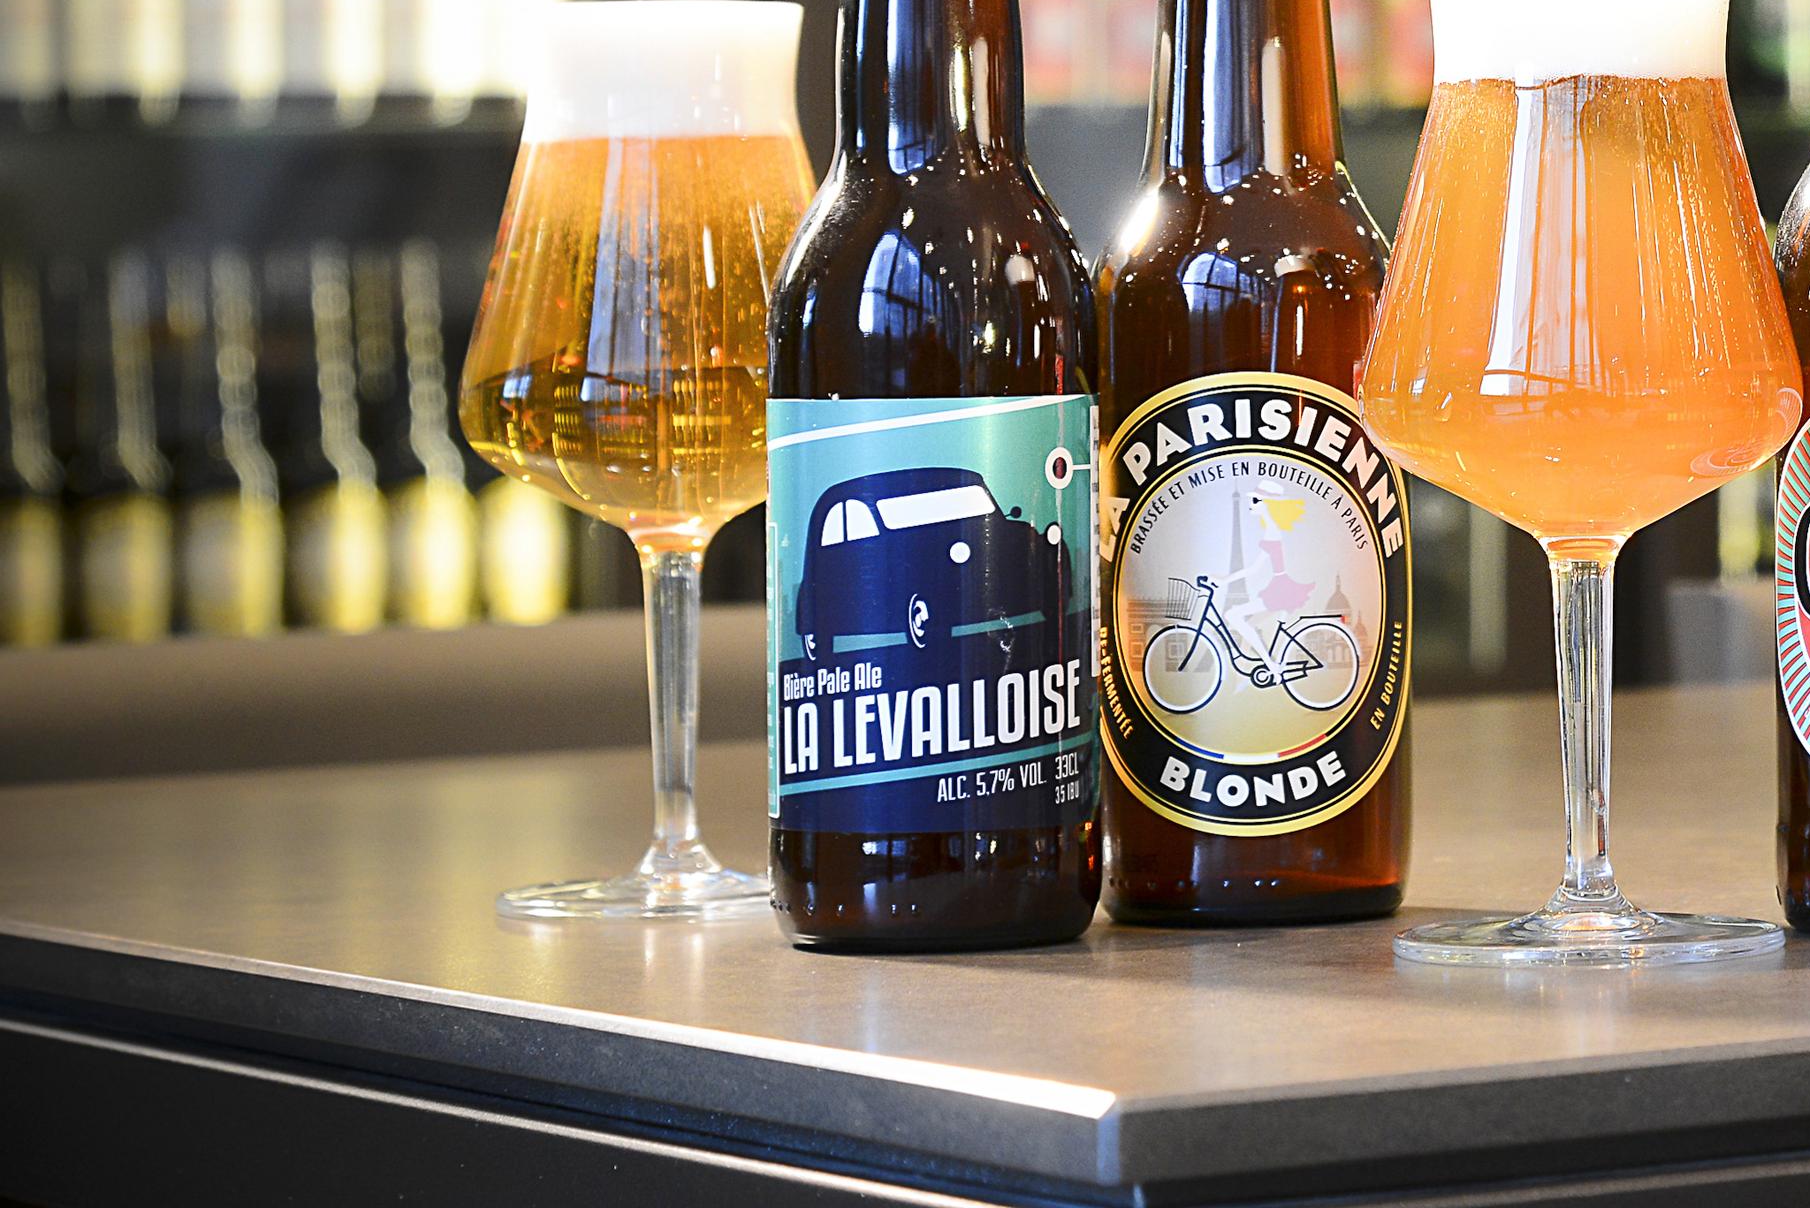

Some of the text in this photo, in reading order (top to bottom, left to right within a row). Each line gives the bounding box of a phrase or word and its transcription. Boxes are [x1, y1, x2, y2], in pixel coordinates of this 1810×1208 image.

[1121, 398, 1404, 558] PARISIENNE
[1130, 461, 1368, 554] BRASSÉE ET MISE EN BOUTEILLE À PARIS
[783, 662, 882, 701] Bière Pale Ale
[1370, 621, 1402, 730] EN BOUTEILLE
[784, 659, 1080, 775] LA LEVALLOISE
[937, 752, 1079, 803] ALC. 5,7% VOL. 33CL
[1055, 784, 1065, 804] 35
[1159, 750, 1347, 807] BLONDE
